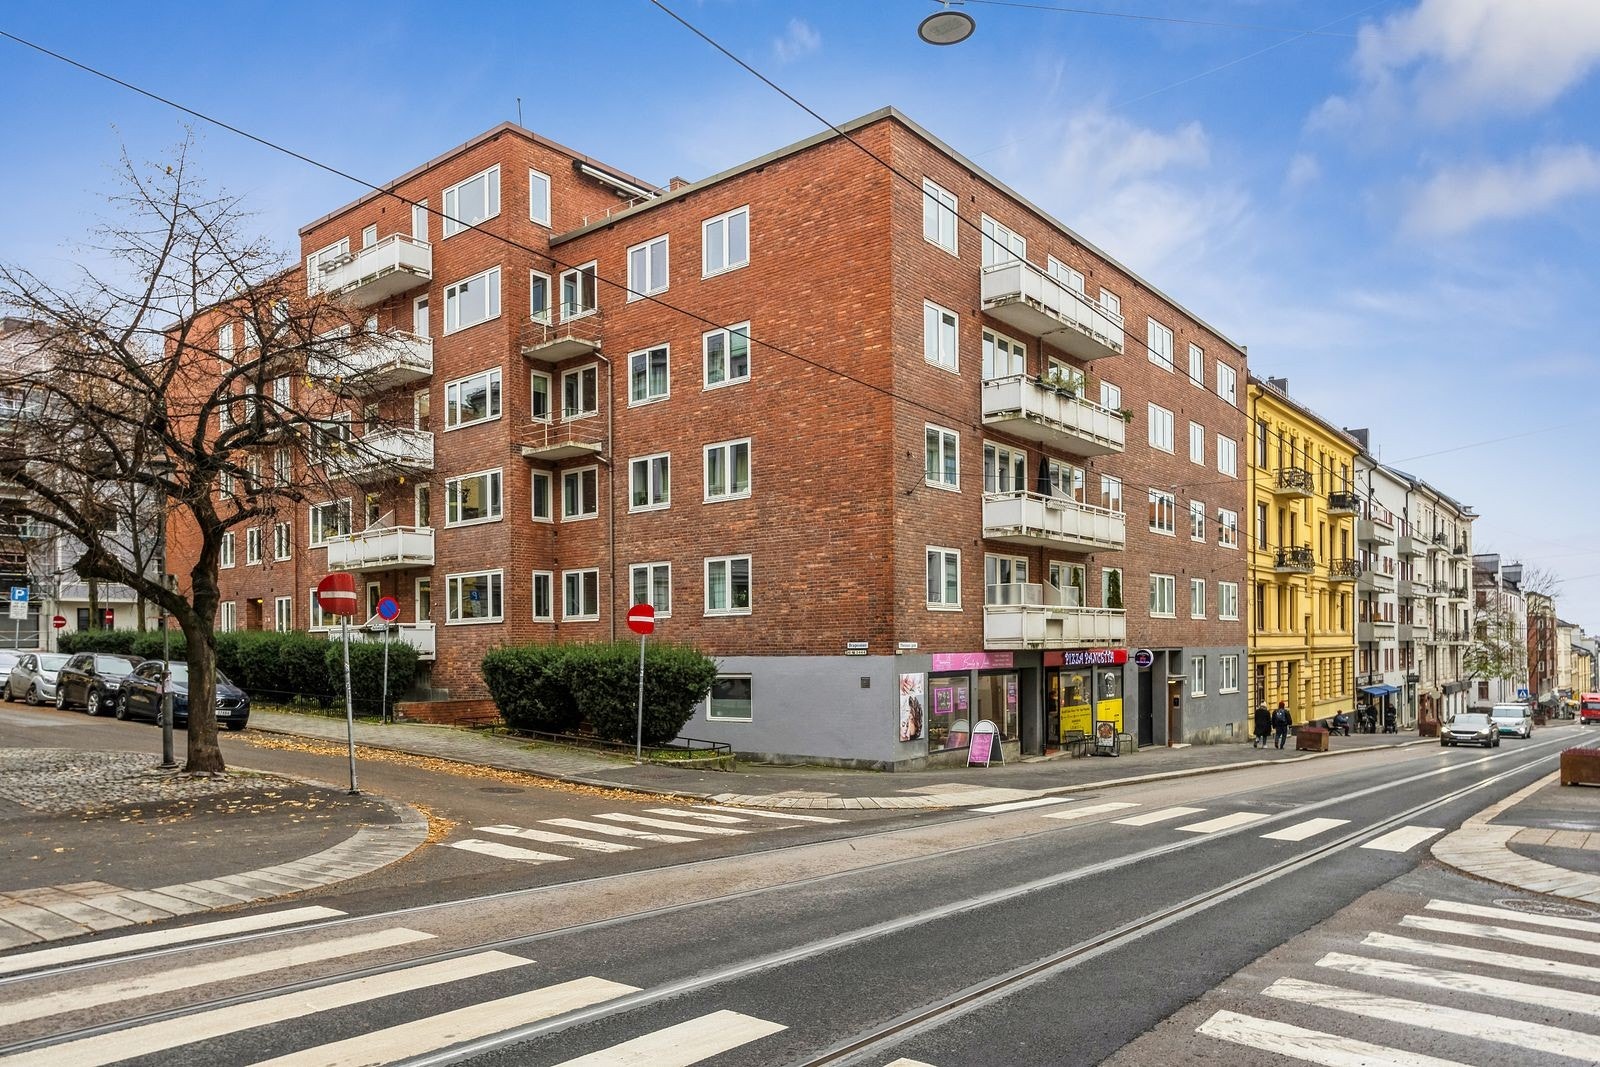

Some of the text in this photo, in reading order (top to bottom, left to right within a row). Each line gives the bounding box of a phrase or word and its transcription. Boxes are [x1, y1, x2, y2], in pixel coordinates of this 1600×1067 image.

[15, 589, 25, 600] P
[1065, 650, 1115, 665] PIZZA PANCETTA
